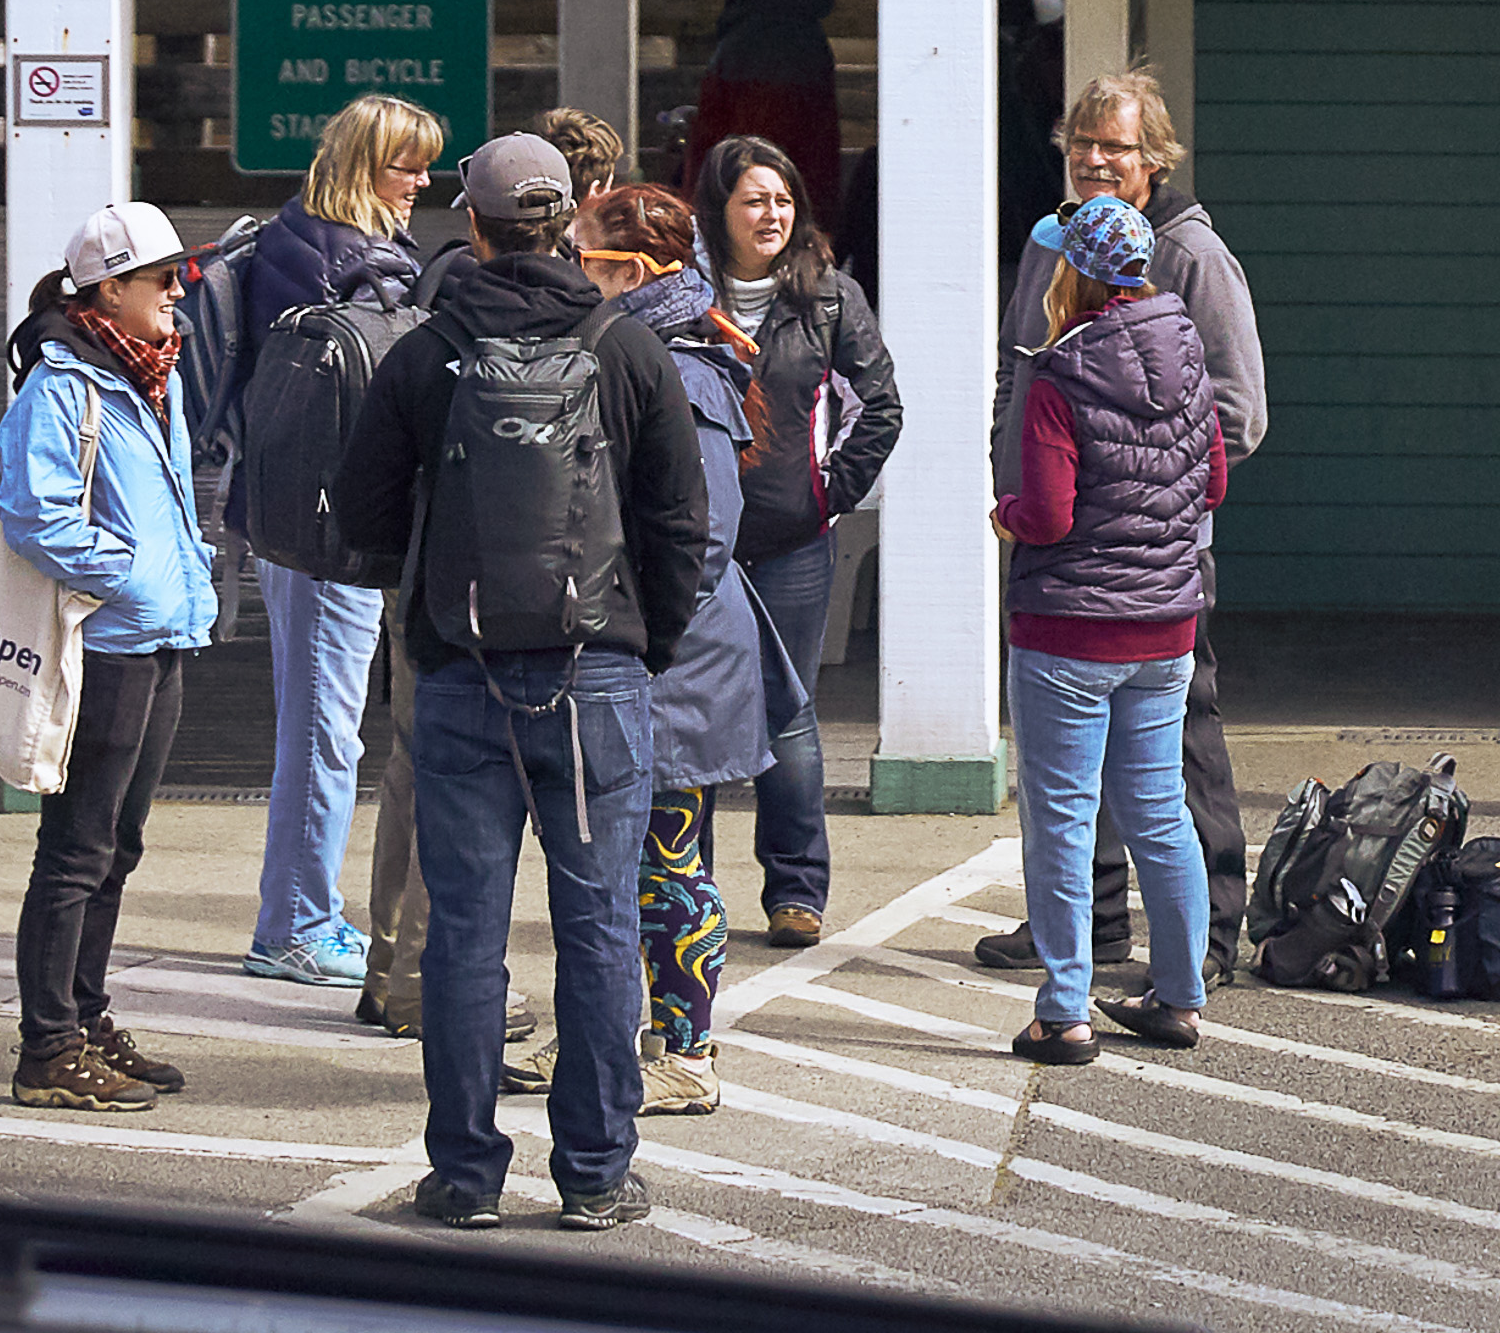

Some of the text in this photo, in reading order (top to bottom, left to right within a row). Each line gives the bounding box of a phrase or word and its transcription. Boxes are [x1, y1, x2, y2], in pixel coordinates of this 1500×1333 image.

[292, 4, 433, 30] PASSENGER
[279, 58, 445, 84] AND BICYCLE
[492, 417, 555, 445] OR
